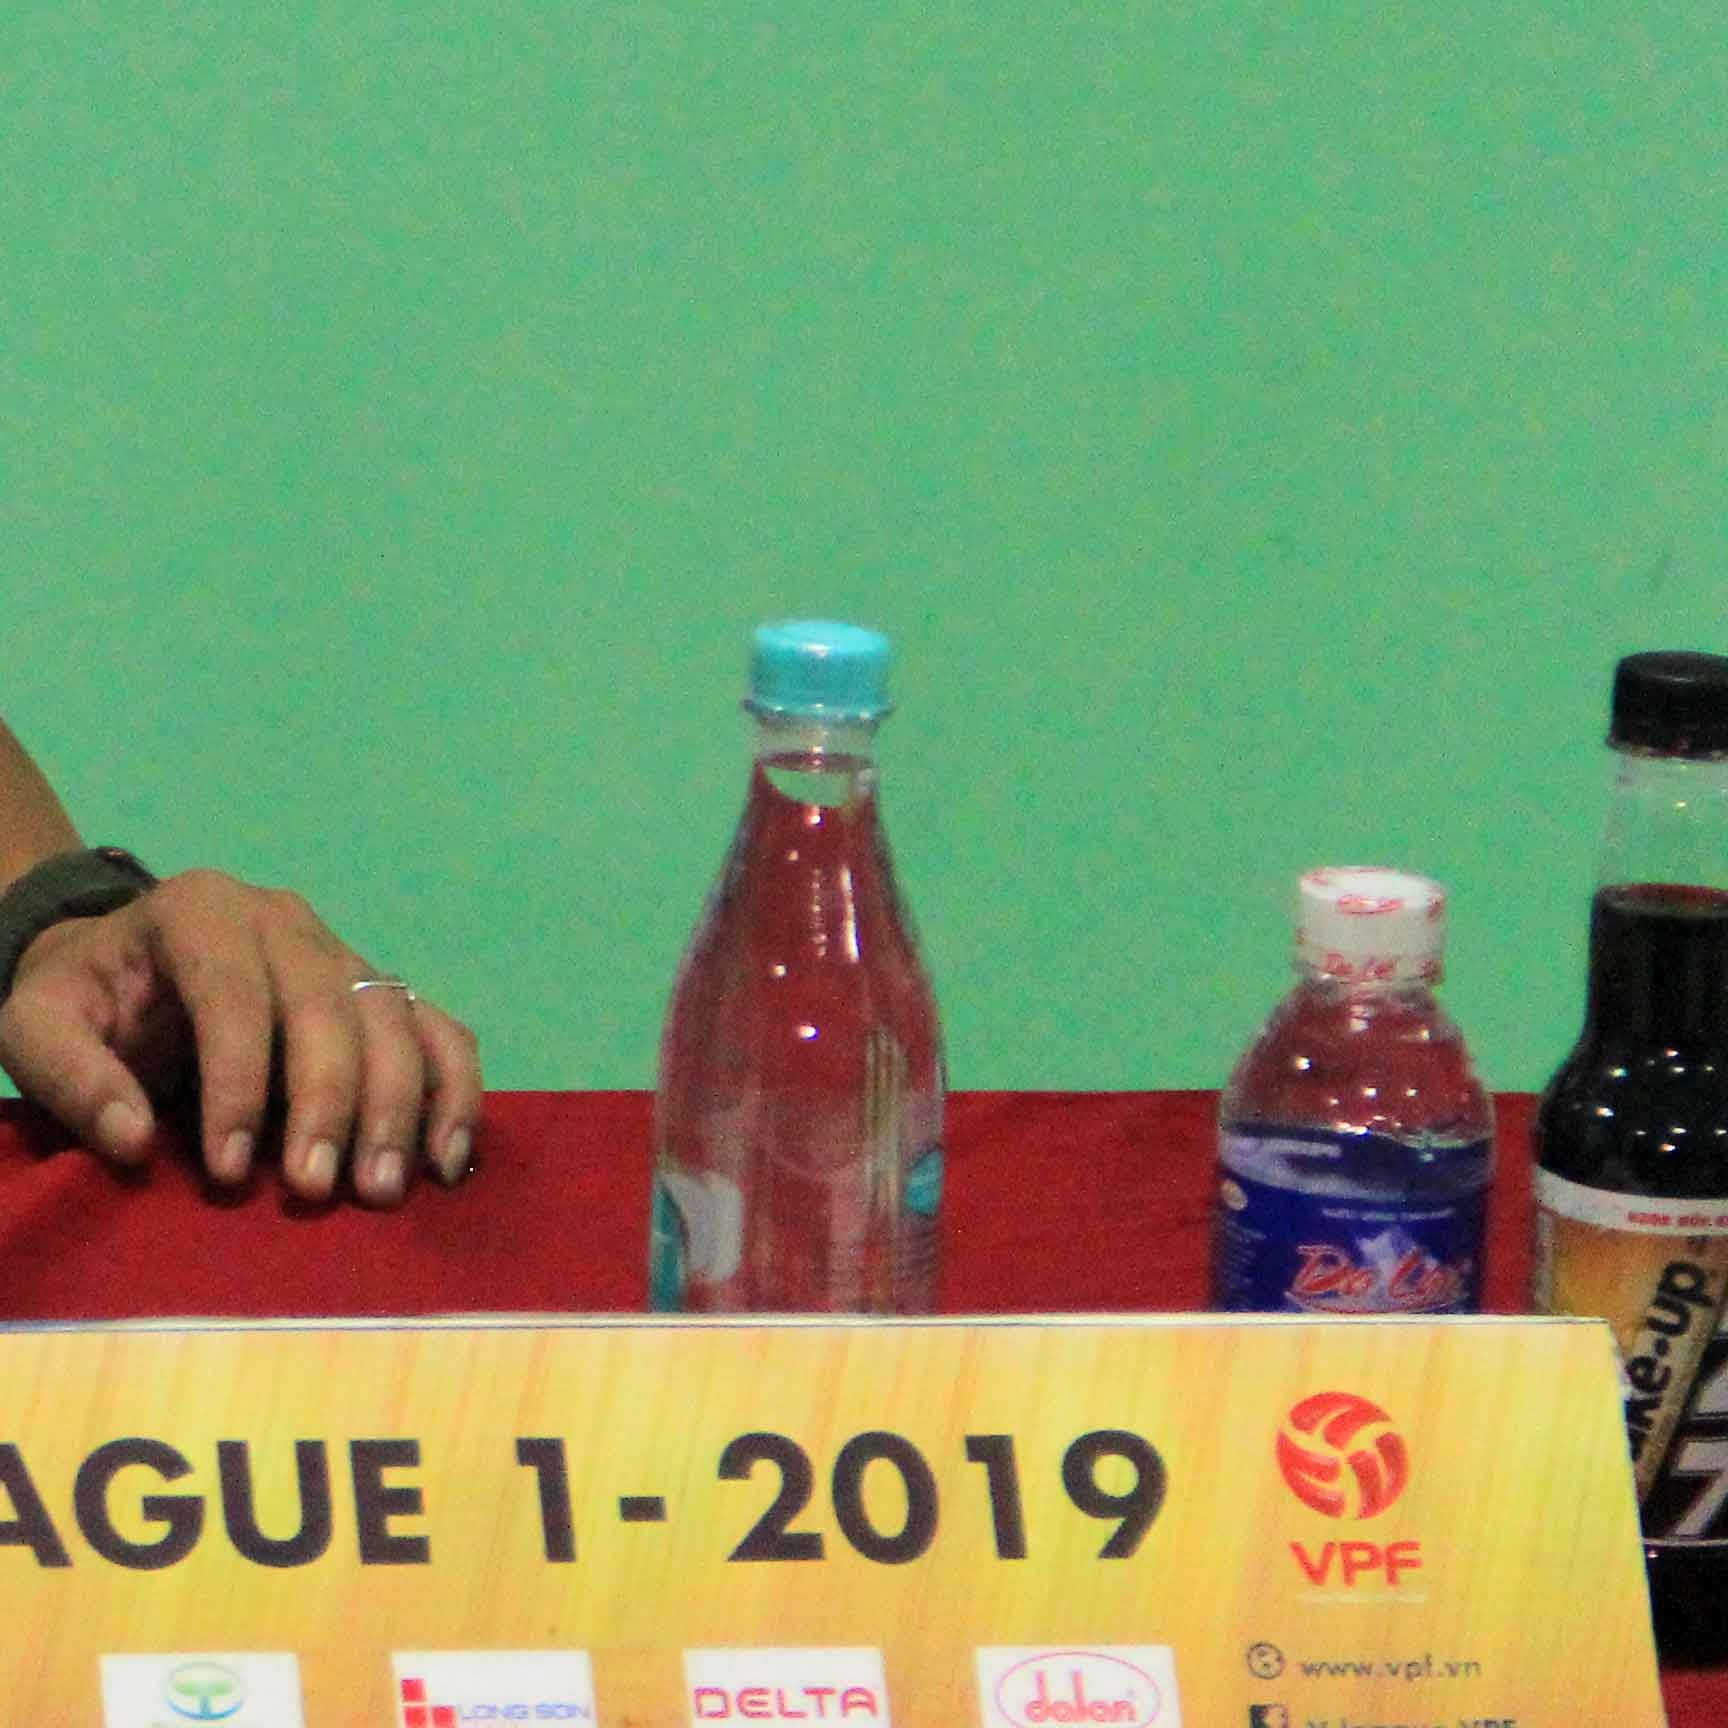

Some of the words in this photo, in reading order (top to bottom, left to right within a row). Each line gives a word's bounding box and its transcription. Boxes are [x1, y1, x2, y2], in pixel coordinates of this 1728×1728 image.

[717, 1429, 1167, 1565] 2019
[1290, 1541, 1422, 1586] VPF
[1300, 1653, 1482, 1681] www.vpf.vn
[462, 1702, 528, 1720] LONG
[535, 1702, 590, 1720] SON
[694, 1687, 878, 1720] DELTA
